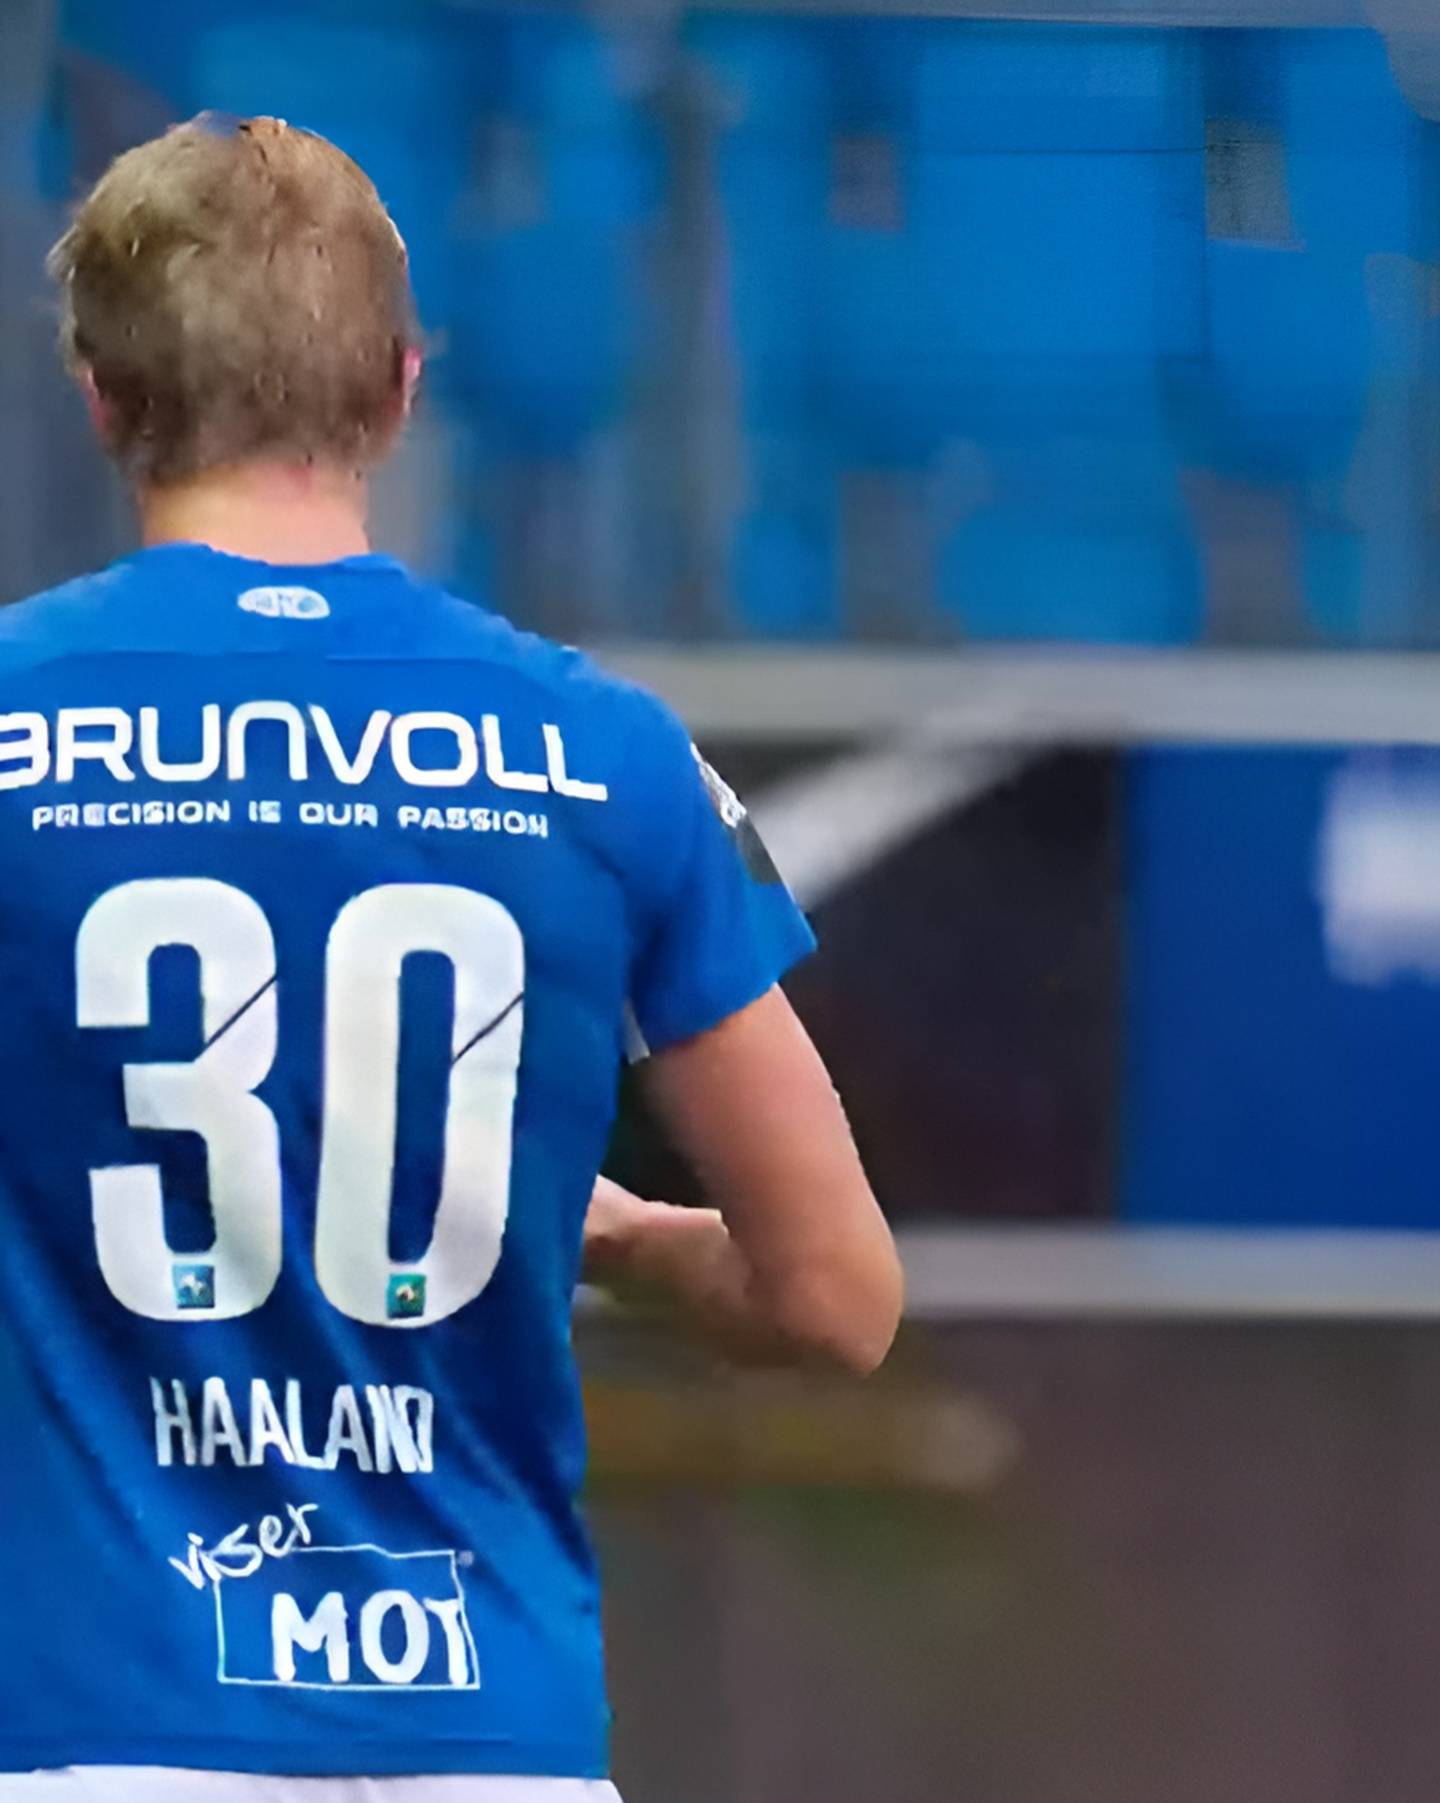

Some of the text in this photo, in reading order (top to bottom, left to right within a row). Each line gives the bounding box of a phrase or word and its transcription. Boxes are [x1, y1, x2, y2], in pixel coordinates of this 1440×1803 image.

[32, 800, 550, 838] PRECISION IS OUR PASSION
[75, 877, 525, 1329] 30
[167, 1502, 319, 1590] viser
[271, 1588, 469, 1687] MOT
